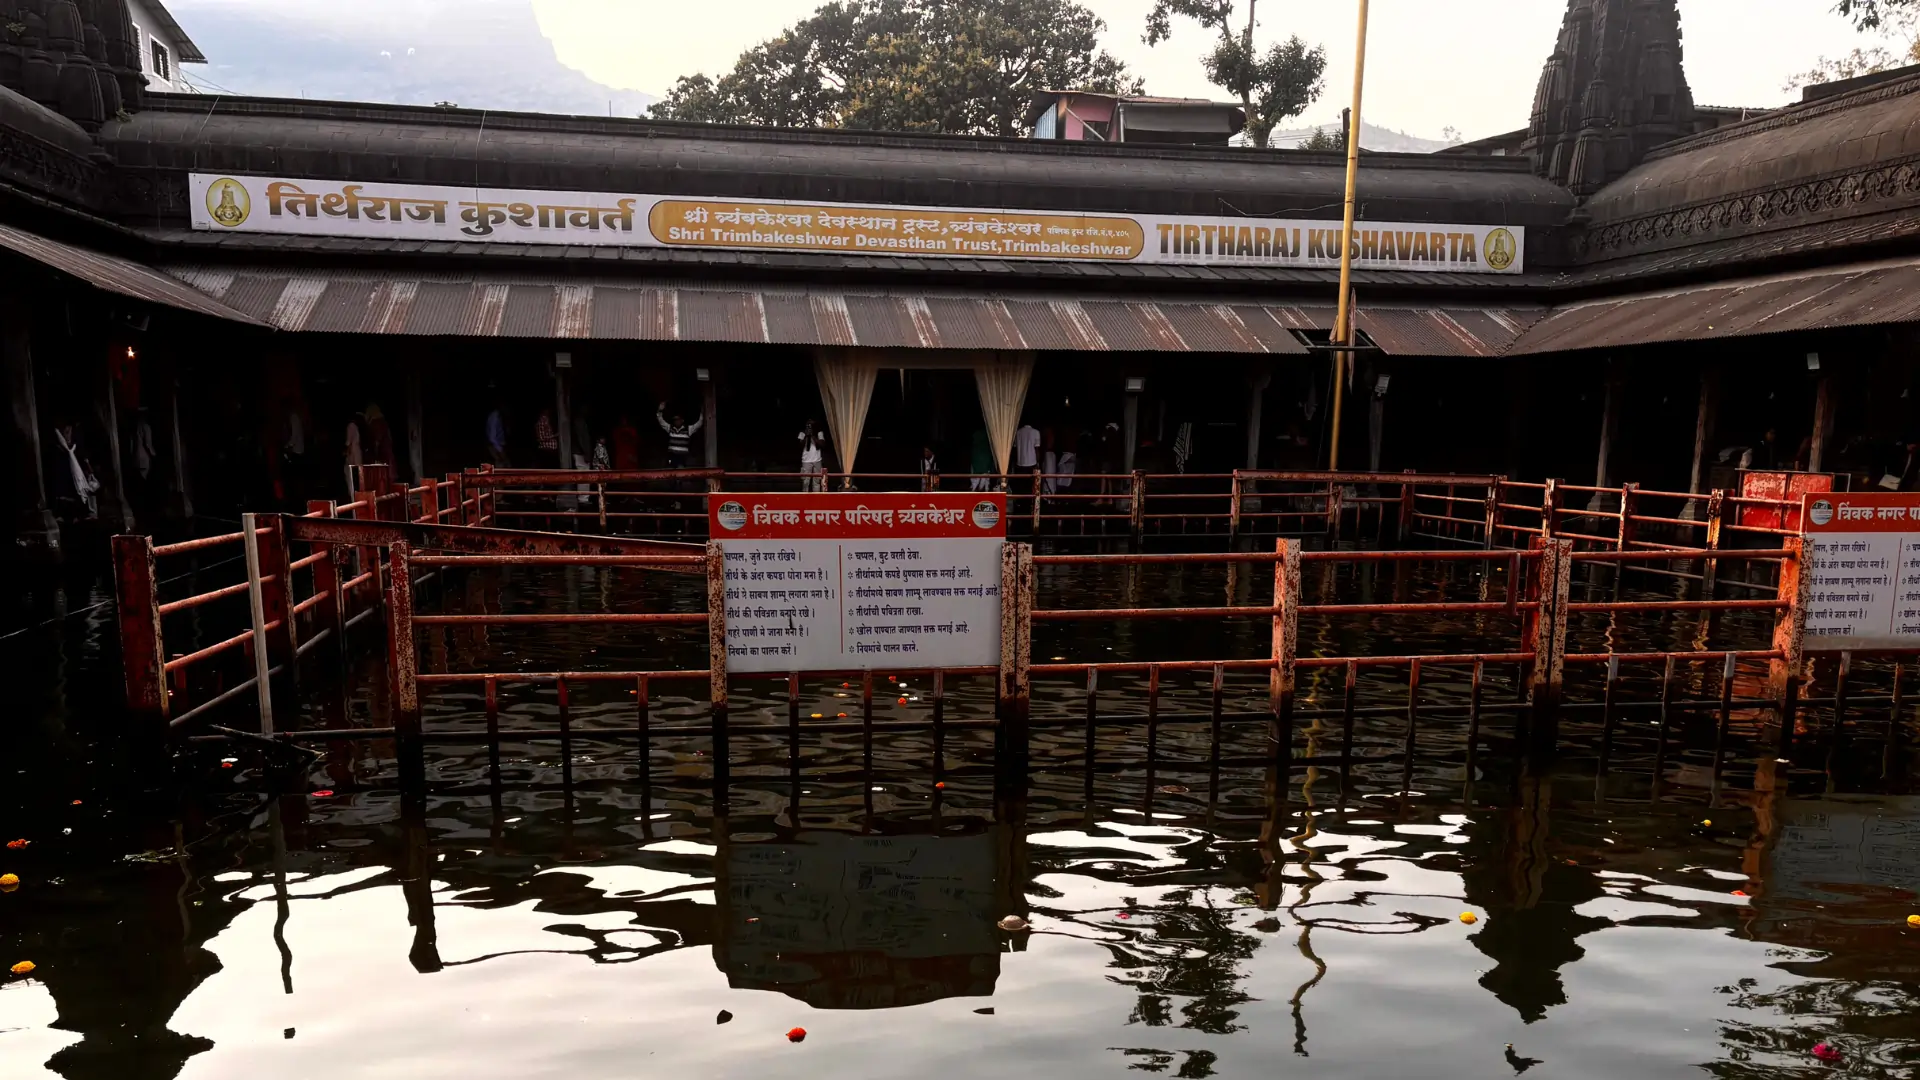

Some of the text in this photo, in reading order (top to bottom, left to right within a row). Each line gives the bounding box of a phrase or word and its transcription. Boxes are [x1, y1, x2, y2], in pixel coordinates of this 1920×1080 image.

[265, 182, 637, 235] तिर्थराज कुशावर्त
[684, 206, 708, 224] श्री
[818, 210, 897, 230] देवस्थान
[669, 227, 705, 240] Shri
[711, 228, 850, 246] Trimbakeshwar
[855, 234, 946, 249] Devasthan
[1156, 224, 1477, 262] TIRTHARAJ KUSHAVARTA
[753, 503, 800, 525] त्रिंबक
[804, 509, 840, 525] नगर
[845, 504, 894, 528] परिषद
